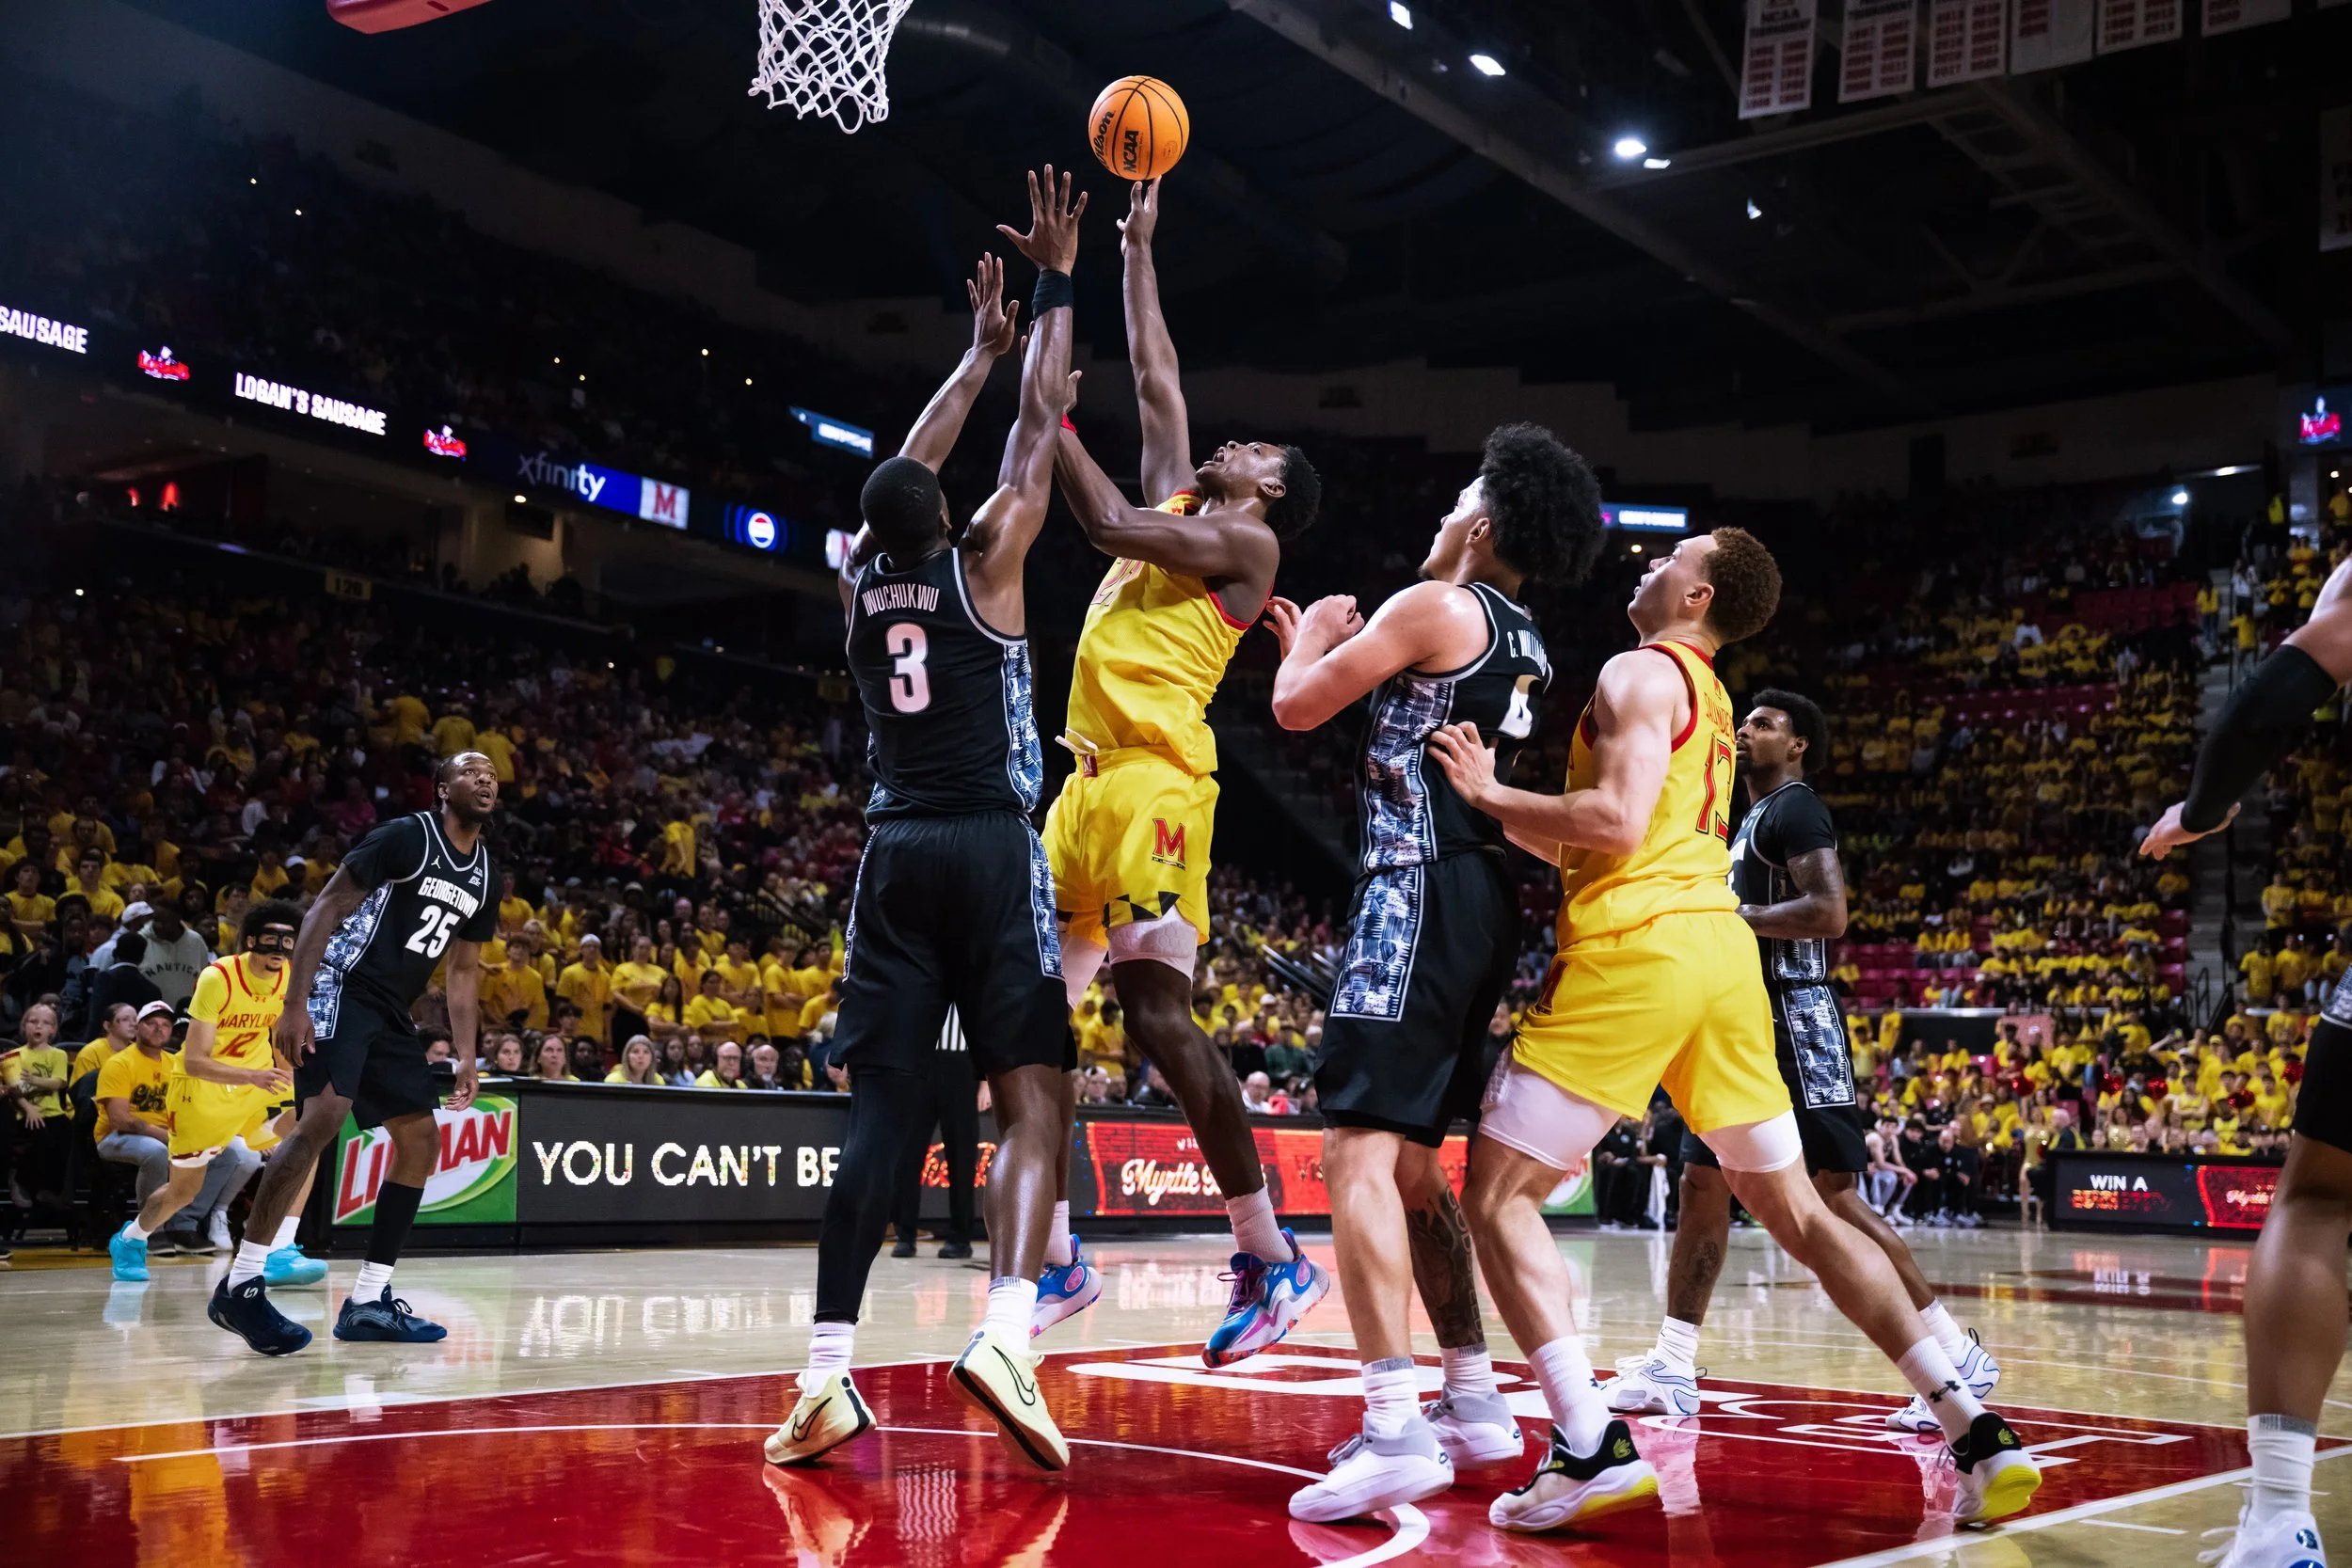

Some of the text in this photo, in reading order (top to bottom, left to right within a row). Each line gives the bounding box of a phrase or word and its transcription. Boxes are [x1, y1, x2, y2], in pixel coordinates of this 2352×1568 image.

[1123, 130, 1139, 173] NCAA
[0, 306, 88, 354] SAUSAGE
[234, 372, 387, 436] LOGAN'S SAUSAGE
[517, 451, 606, 502] xfinity
[655, 482, 677, 519] M
[1507, 631, 1518, 658] C.
[886, 622, 931, 714] 3
[1152, 818, 1186, 863] M
[418, 876, 480, 920] GEORGETOWN
[405, 905, 460, 958] 25
[218, 1032, 260, 1058] 12
[532, 1140, 634, 1185] YOU
[651, 1142, 782, 1187] CAN'T
[1121, 1158, 1200, 1206] Myrtle
[2090, 1174, 2149, 1193] WIN A
